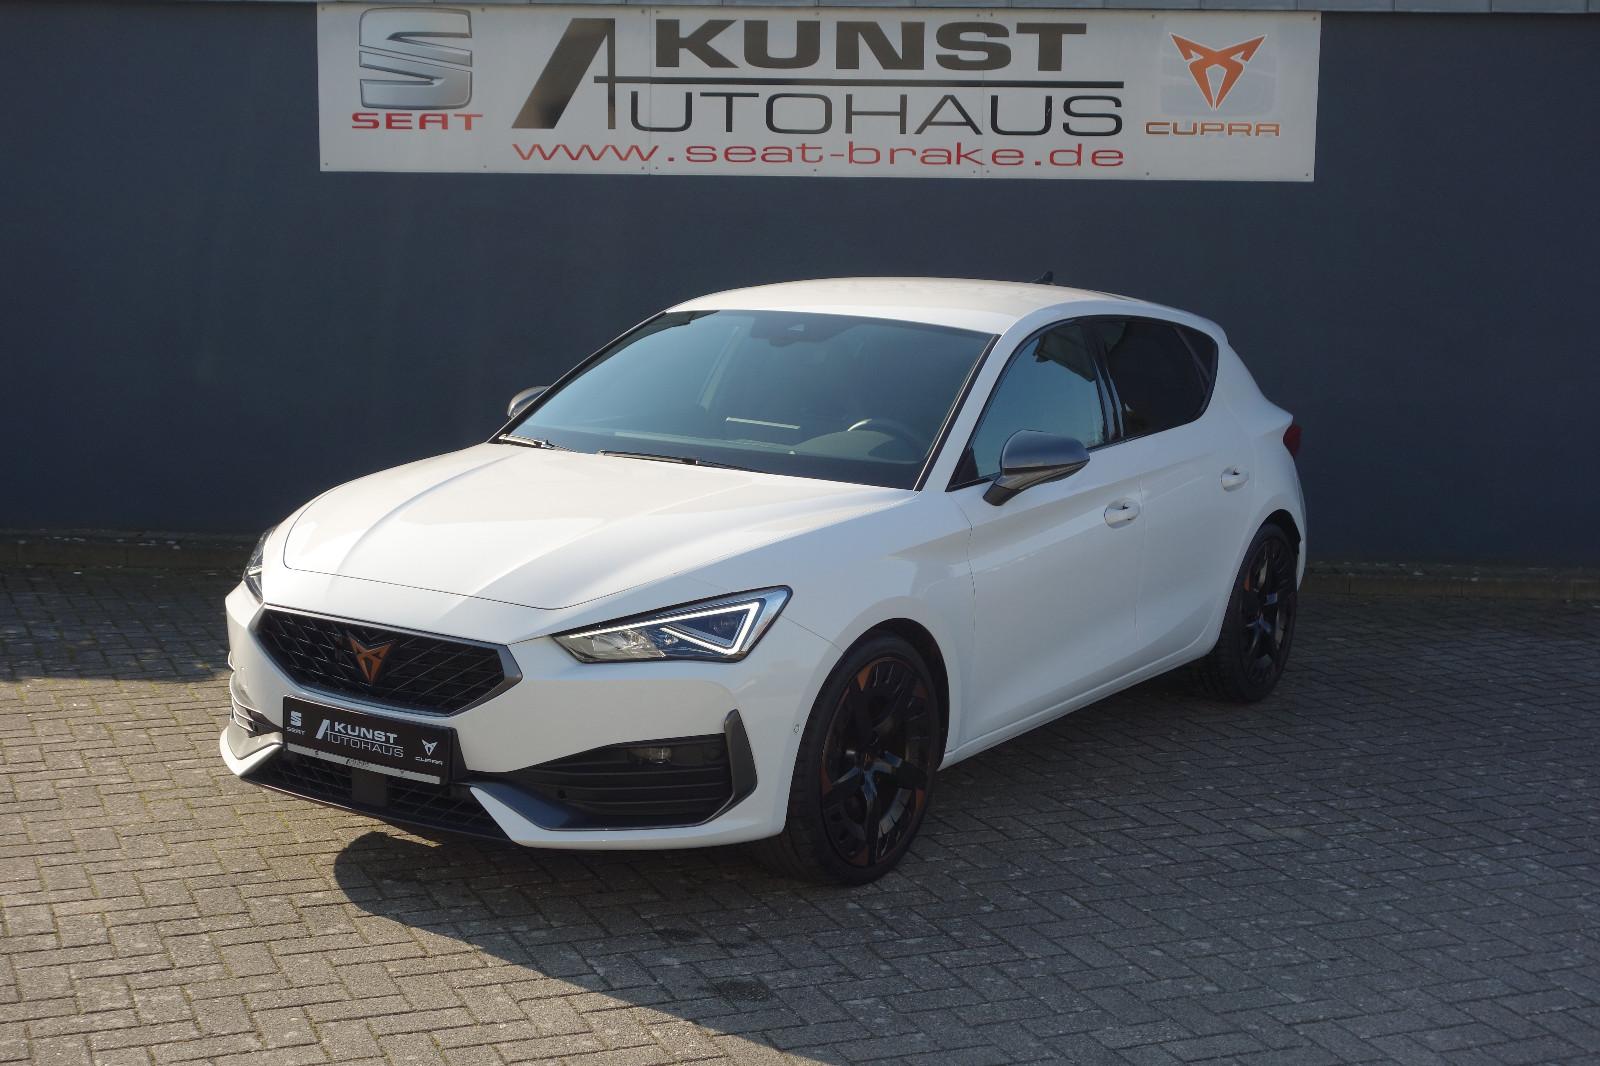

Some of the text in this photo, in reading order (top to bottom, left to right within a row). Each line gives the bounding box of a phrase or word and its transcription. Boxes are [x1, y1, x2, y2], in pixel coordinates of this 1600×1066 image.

[655, 18, 1087, 71] KUNST
[511, 17, 1124, 136] AUTOHAUS
[351, 112, 483, 131] SEAT
[1144, 121, 1281, 137] CUPRA
[512, 140, 1124, 168] www.seat-brake.de
[286, 725, 306, 736] SEAT
[315, 719, 404, 758] AUTOHAUS
[334, 721, 398, 744] KUNST
